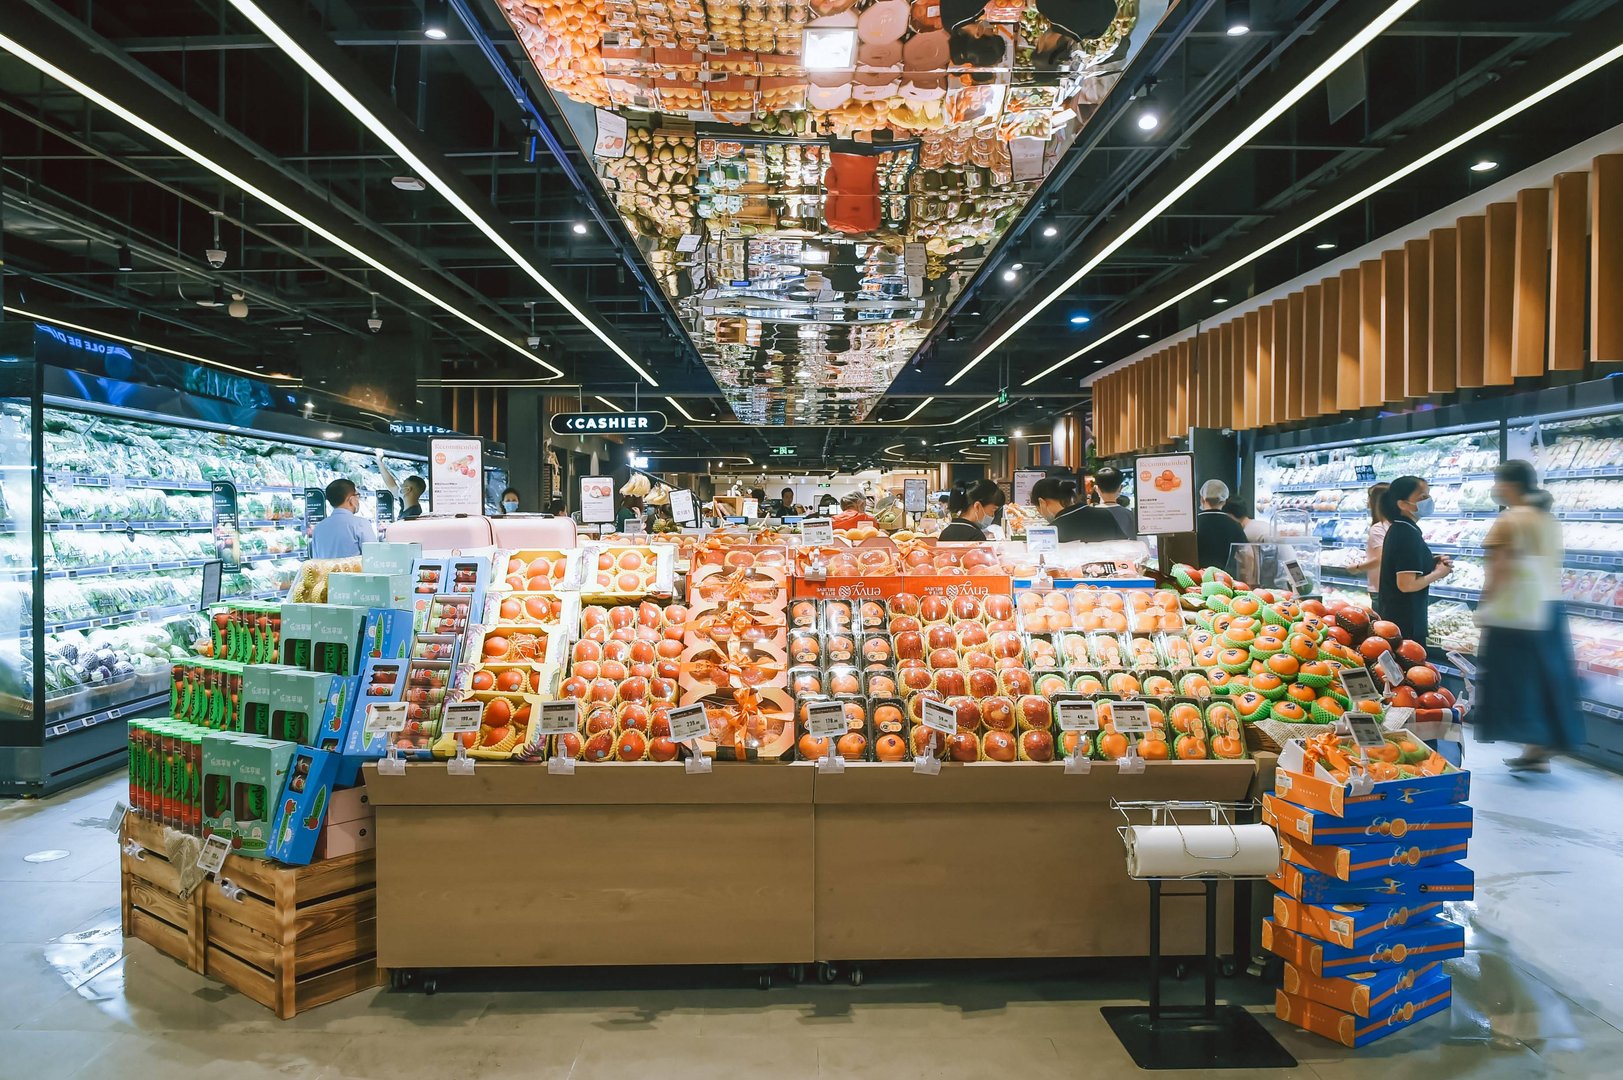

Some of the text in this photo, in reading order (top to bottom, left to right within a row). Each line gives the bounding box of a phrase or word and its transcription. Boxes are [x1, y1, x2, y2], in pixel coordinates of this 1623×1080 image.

[575, 417, 649, 429] CASHIER
[851, 581, 881, 596] envy
[958, 580, 988, 595] envy
